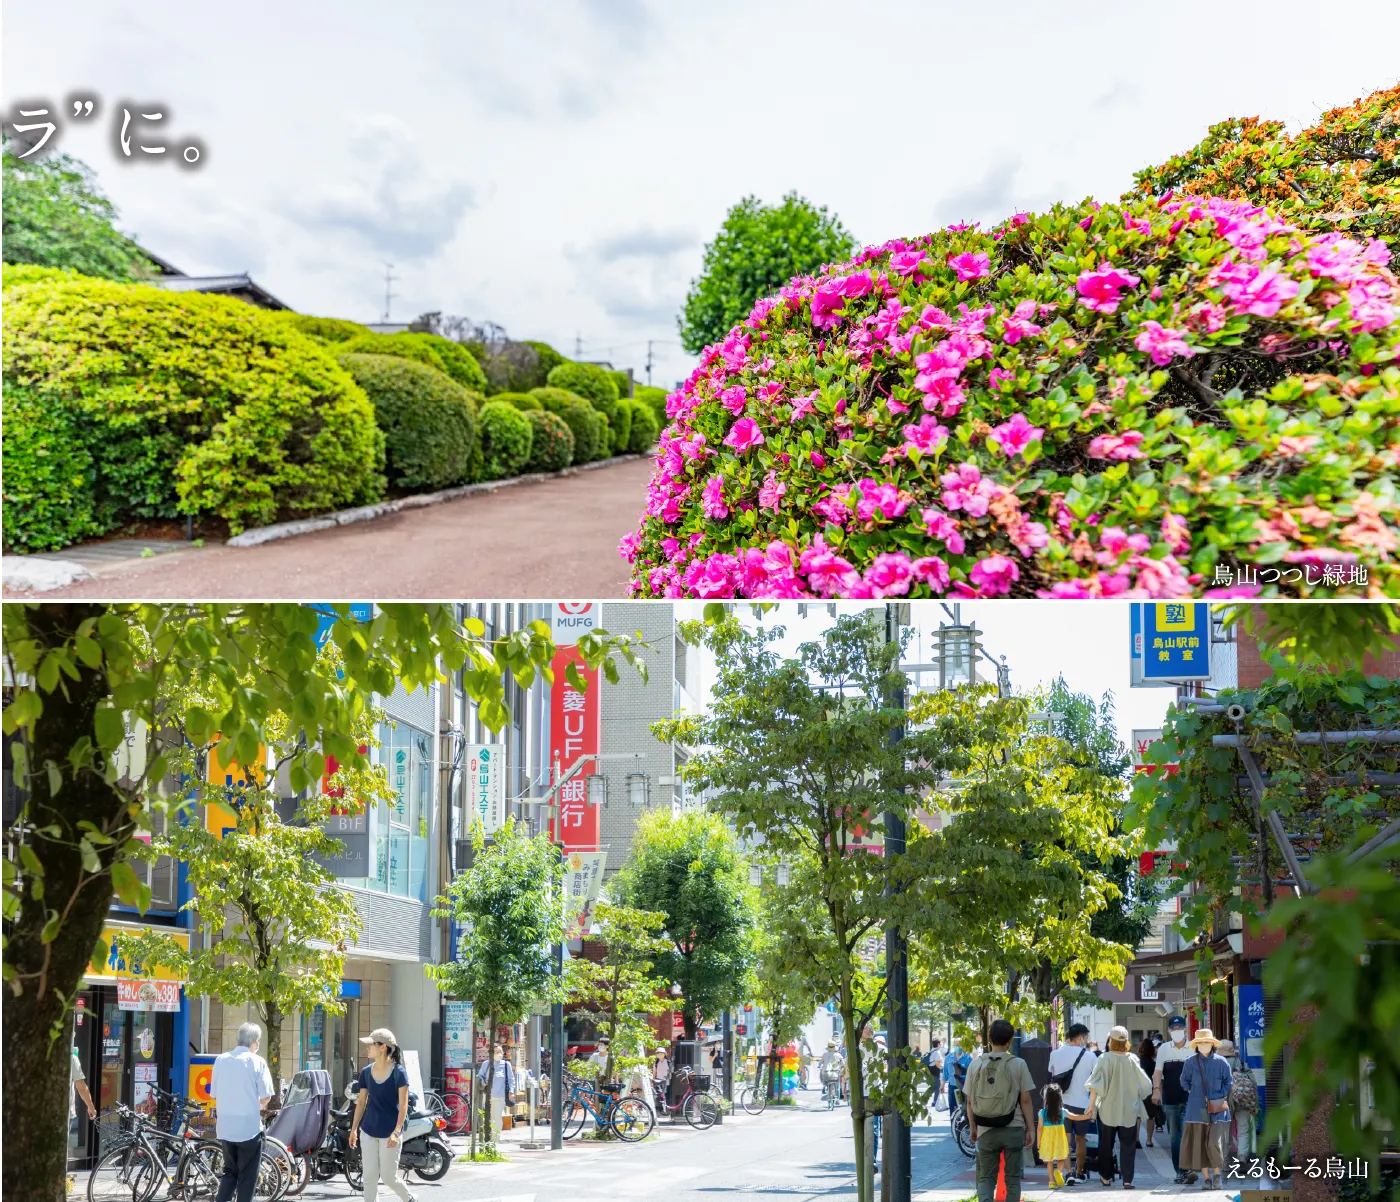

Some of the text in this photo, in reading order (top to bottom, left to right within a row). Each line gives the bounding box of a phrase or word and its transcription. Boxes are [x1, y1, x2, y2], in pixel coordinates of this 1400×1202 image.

[557, 617, 593, 628] MUFG
[561, 664, 586, 828] 菱UF銀行
